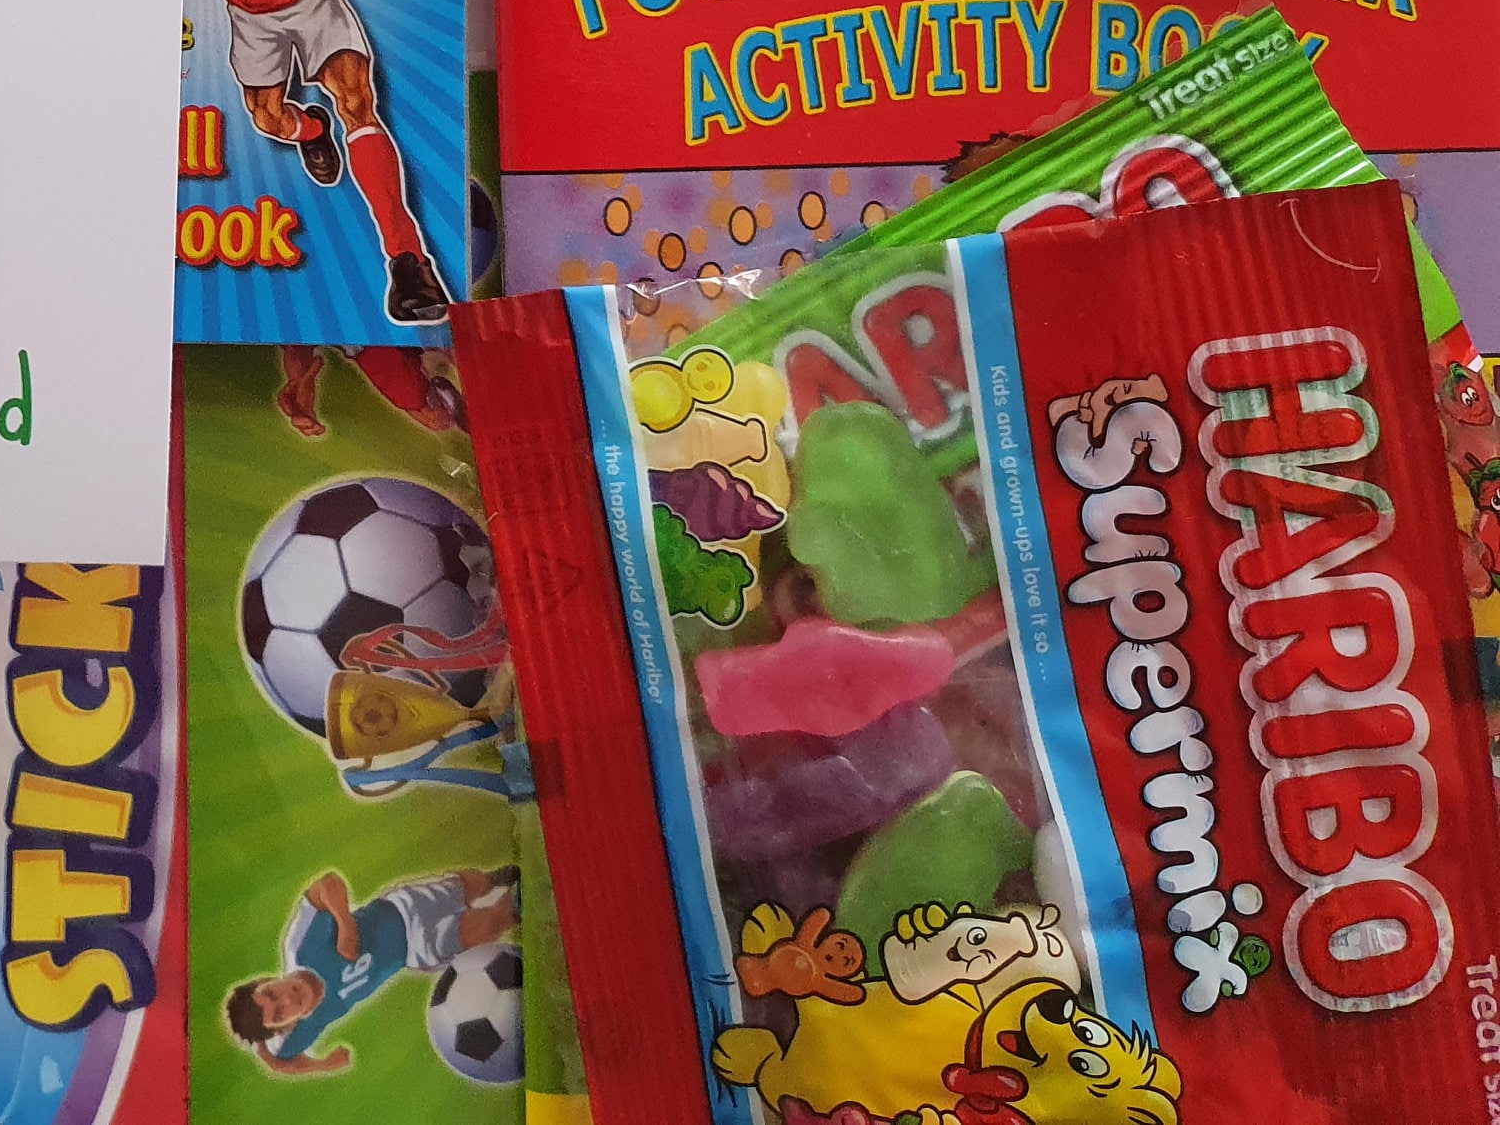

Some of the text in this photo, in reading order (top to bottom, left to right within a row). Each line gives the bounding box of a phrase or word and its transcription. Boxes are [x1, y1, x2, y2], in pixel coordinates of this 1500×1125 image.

[1138, 31, 1289, 121] Treat size
[989, 364, 1011, 407] Kids
[997, 410, 1018, 451] and
[604, 443, 623, 477] the
[607, 480, 630, 544] happy
[999, 454, 1033, 563] grown-ups
[623, 547, 647, 605] world
[1021, 566, 1042, 607] love
[632, 606, 650, 631] of
[1034, 633, 1050, 655] so
[1188, 324, 1455, 1015] HARIBO
[1050, 397, 1270, 1015] Supermix
